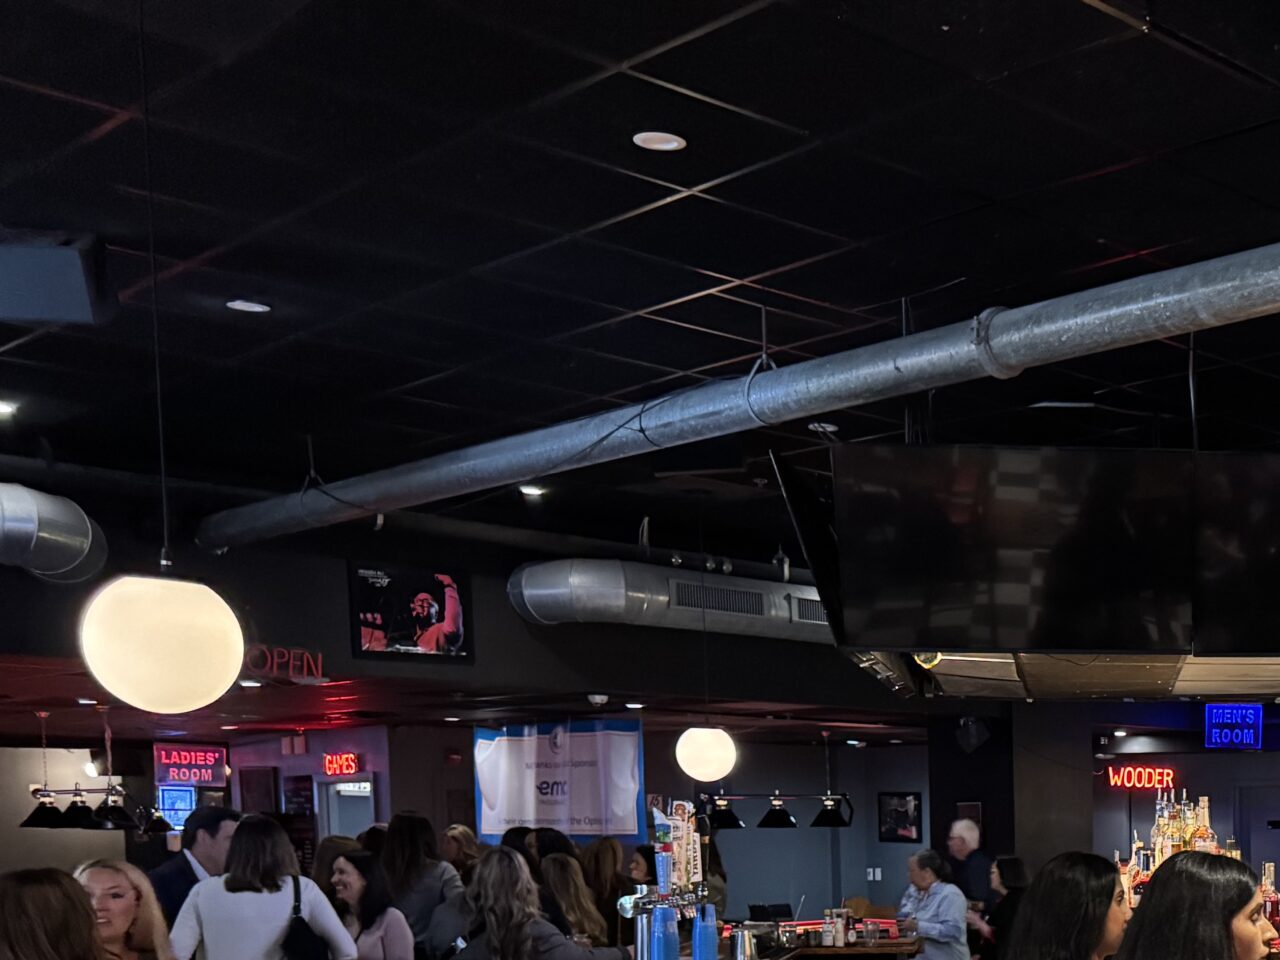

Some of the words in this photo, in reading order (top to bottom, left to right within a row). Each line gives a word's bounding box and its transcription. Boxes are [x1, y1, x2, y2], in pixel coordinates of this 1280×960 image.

[246, 644, 324, 679] OPEN
[1212, 709, 1255, 724] MEN'S
[1212, 728, 1254, 744] ROOM
[161, 751, 219, 765] LADIES'
[325, 753, 356, 776] GAMES
[169, 768, 212, 781] ROOM
[1108, 766, 1174, 788] WOODER
